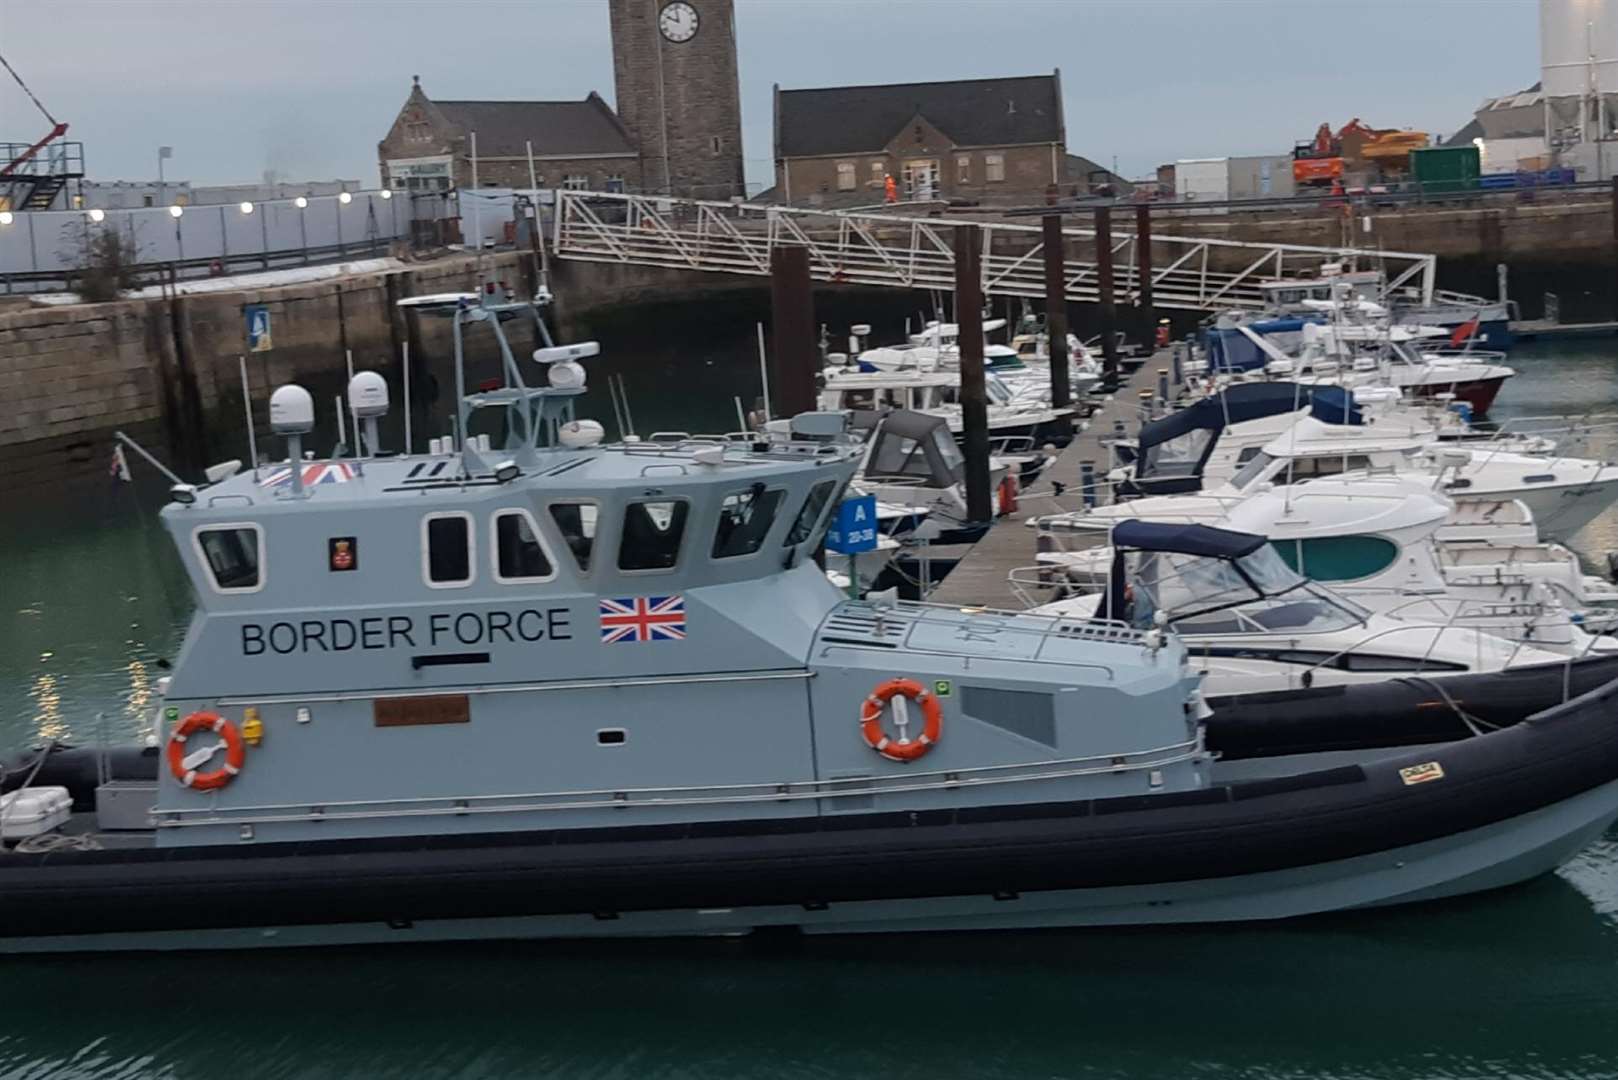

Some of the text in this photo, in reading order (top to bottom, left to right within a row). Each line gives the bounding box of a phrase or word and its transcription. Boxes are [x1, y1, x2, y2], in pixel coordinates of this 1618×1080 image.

[854, 505, 866, 522] A
[241, 608, 572, 655] BORDER FORCE
